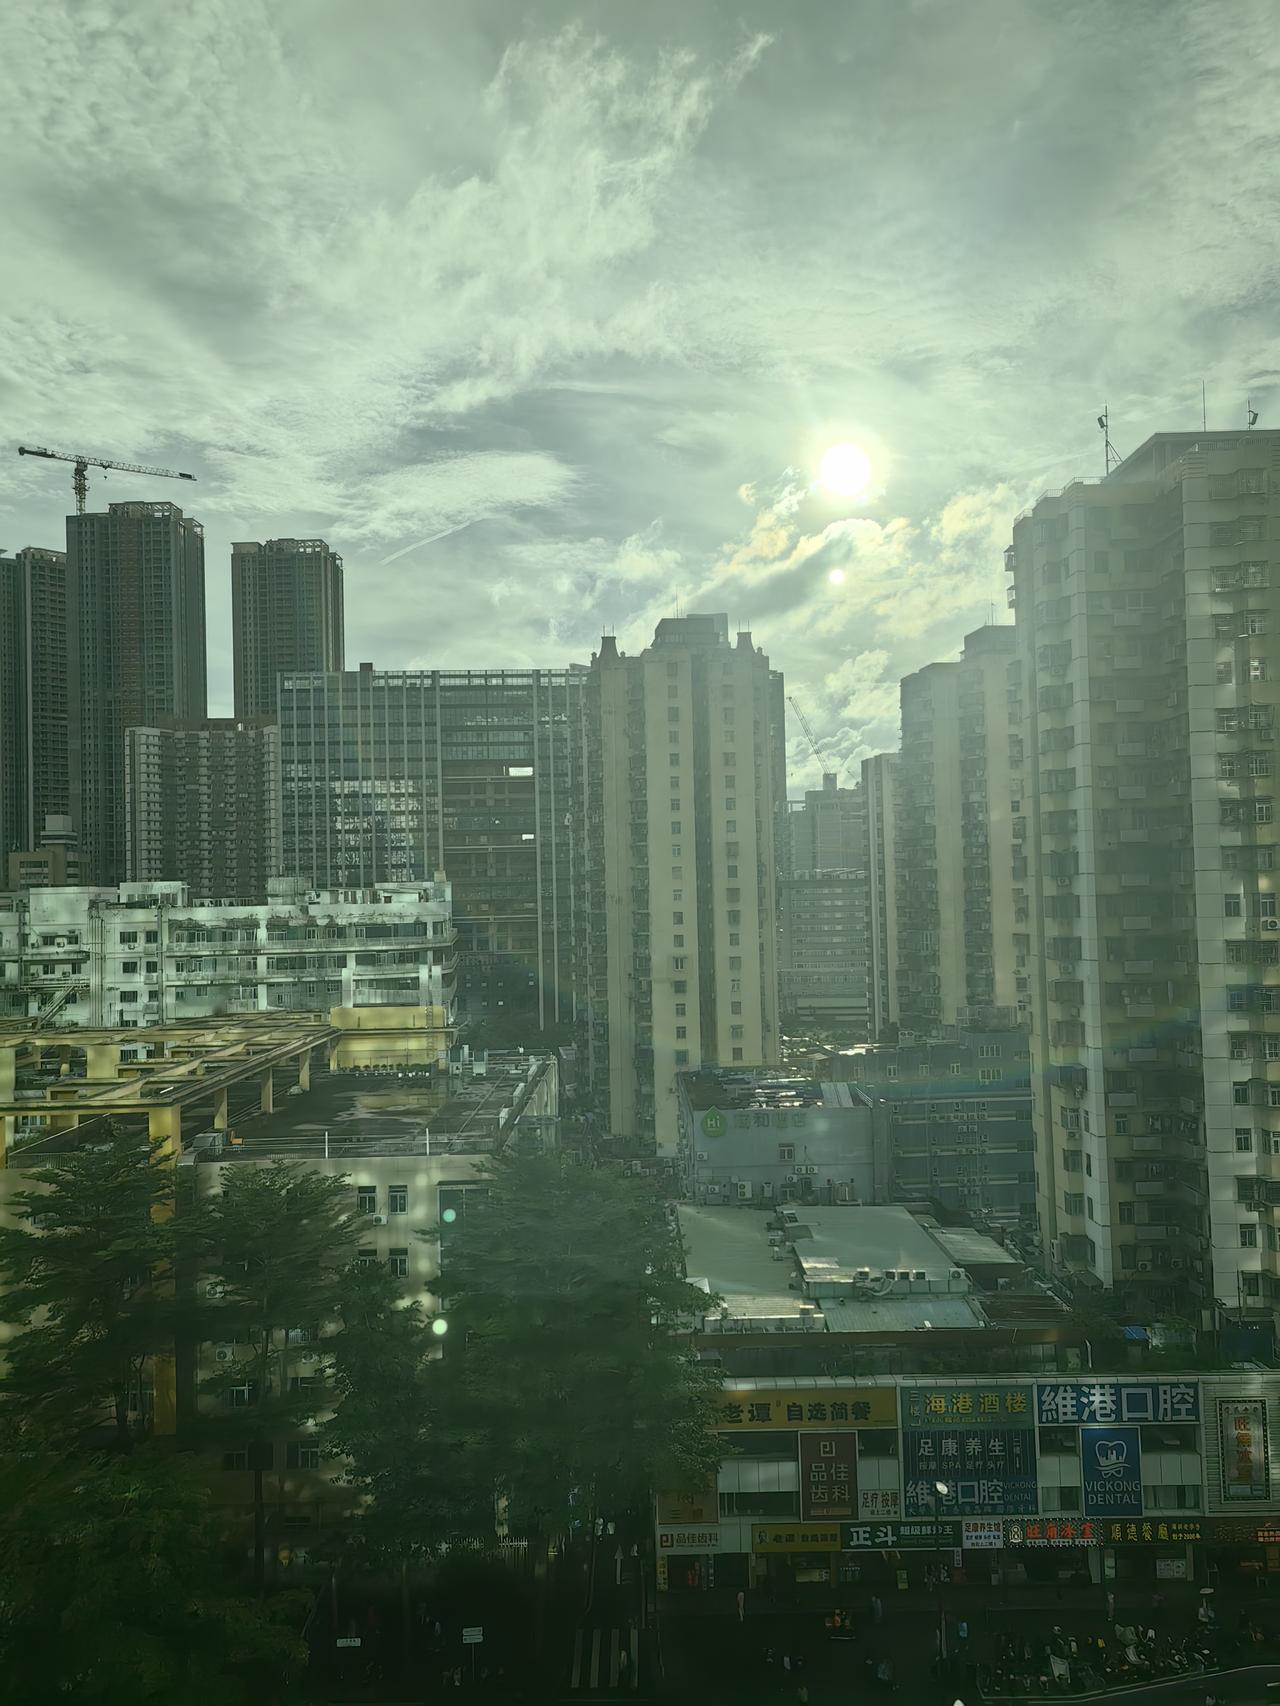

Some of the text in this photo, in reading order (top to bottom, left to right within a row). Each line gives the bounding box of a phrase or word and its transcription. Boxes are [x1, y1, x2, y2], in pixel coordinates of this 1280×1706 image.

[707, 1115, 720, 1127] Hi
[925, 1392, 1026, 1415] 海港酒楼
[1041, 1385, 1196, 1422] 維港口腔
[919, 1438, 1006, 1456] 足康养生
[810, 1463, 849, 1481] 品佳
[943, 1461, 961, 1470] SPA
[810, 1484, 850, 1503] 齿科
[1085, 1480, 1141, 1492] VICKONG
[1088, 1493, 1139, 1505] DENTAL
[676, 1532, 718, 1544] 品佳齿科
[850, 1525, 898, 1546] 正斗
